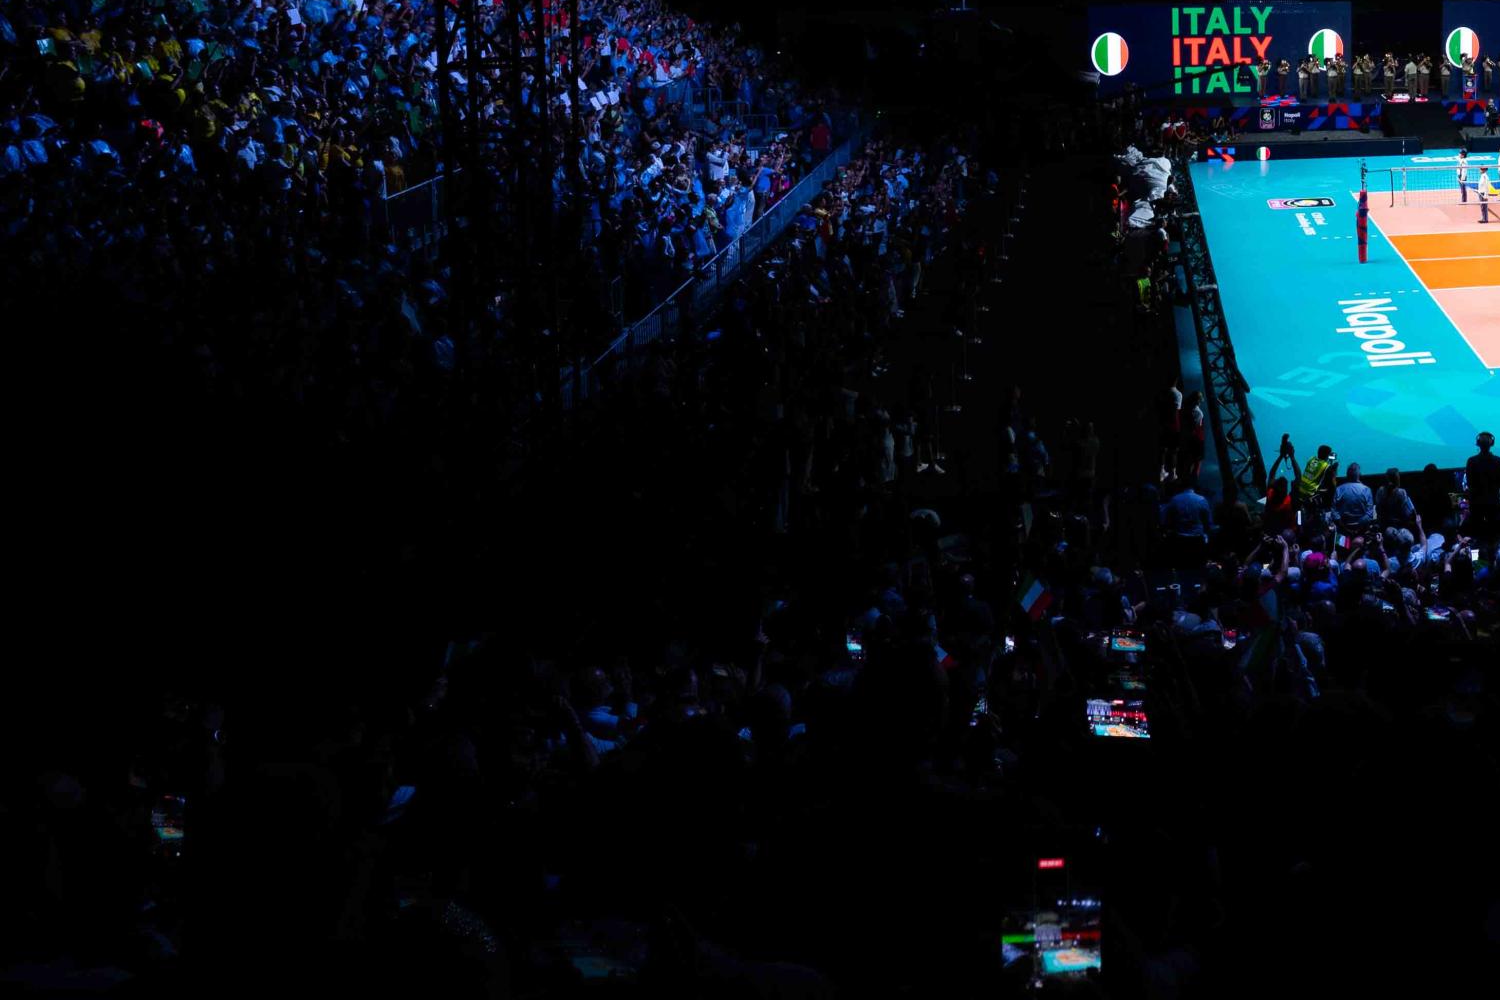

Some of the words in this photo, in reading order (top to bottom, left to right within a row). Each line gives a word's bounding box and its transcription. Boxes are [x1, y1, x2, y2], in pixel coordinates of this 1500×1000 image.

[1171, 6, 1273, 36] ITALY
[1172, 36, 1273, 66] ITALY
[1336, 297, 1437, 368] Napoli
